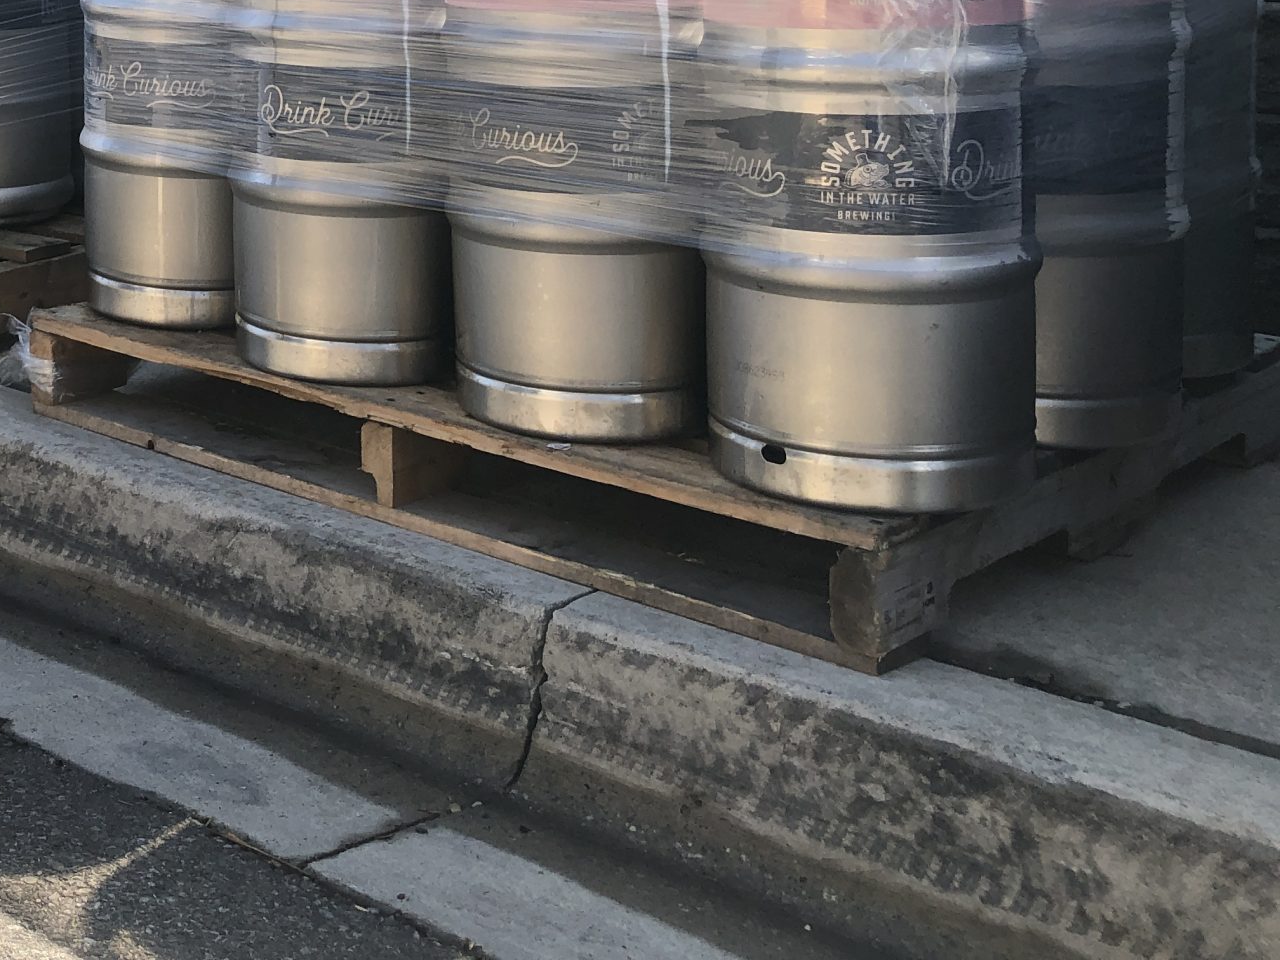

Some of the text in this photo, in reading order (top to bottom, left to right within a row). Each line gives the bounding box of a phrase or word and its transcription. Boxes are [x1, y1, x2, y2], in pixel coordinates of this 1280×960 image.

[120, 61, 216, 109] Curious
[261, 84, 336, 137] Drink
[469, 107, 579, 168] Curious
[820, 129, 915, 188] SOMETHING
[820, 190, 915, 206] IN THE WATER
